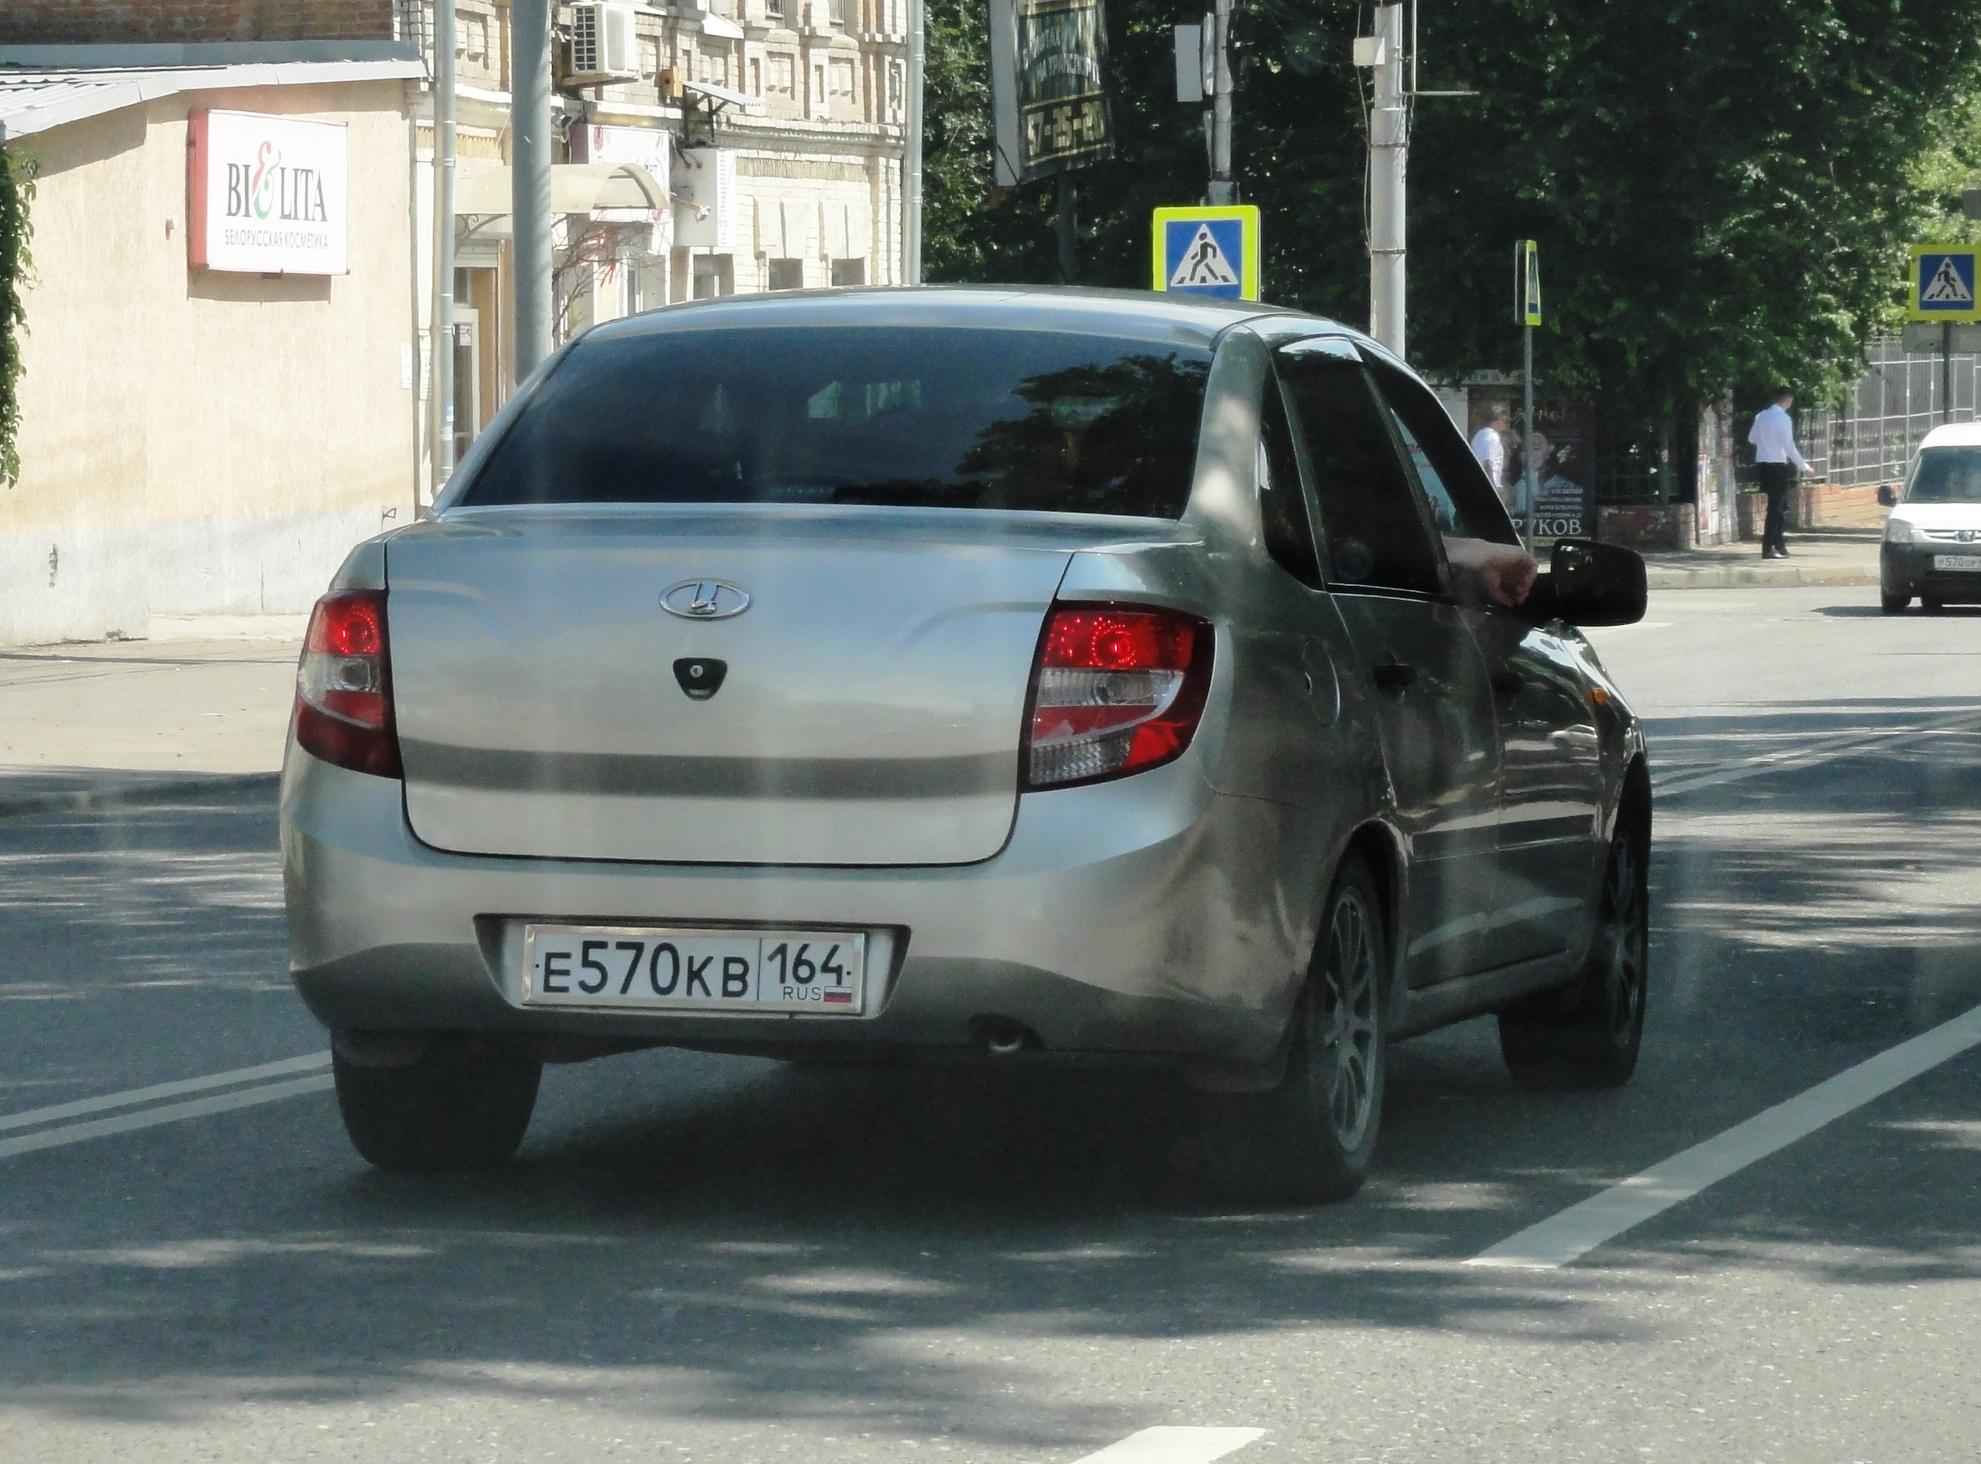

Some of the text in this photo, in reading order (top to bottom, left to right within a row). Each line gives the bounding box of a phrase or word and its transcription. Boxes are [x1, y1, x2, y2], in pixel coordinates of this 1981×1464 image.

[225, 228, 329, 250] БЕЛОРУССКАЯ КОСМЕТИКА
[767, 943, 844, 985] 164
[782, 986, 822, 1001] RUS
